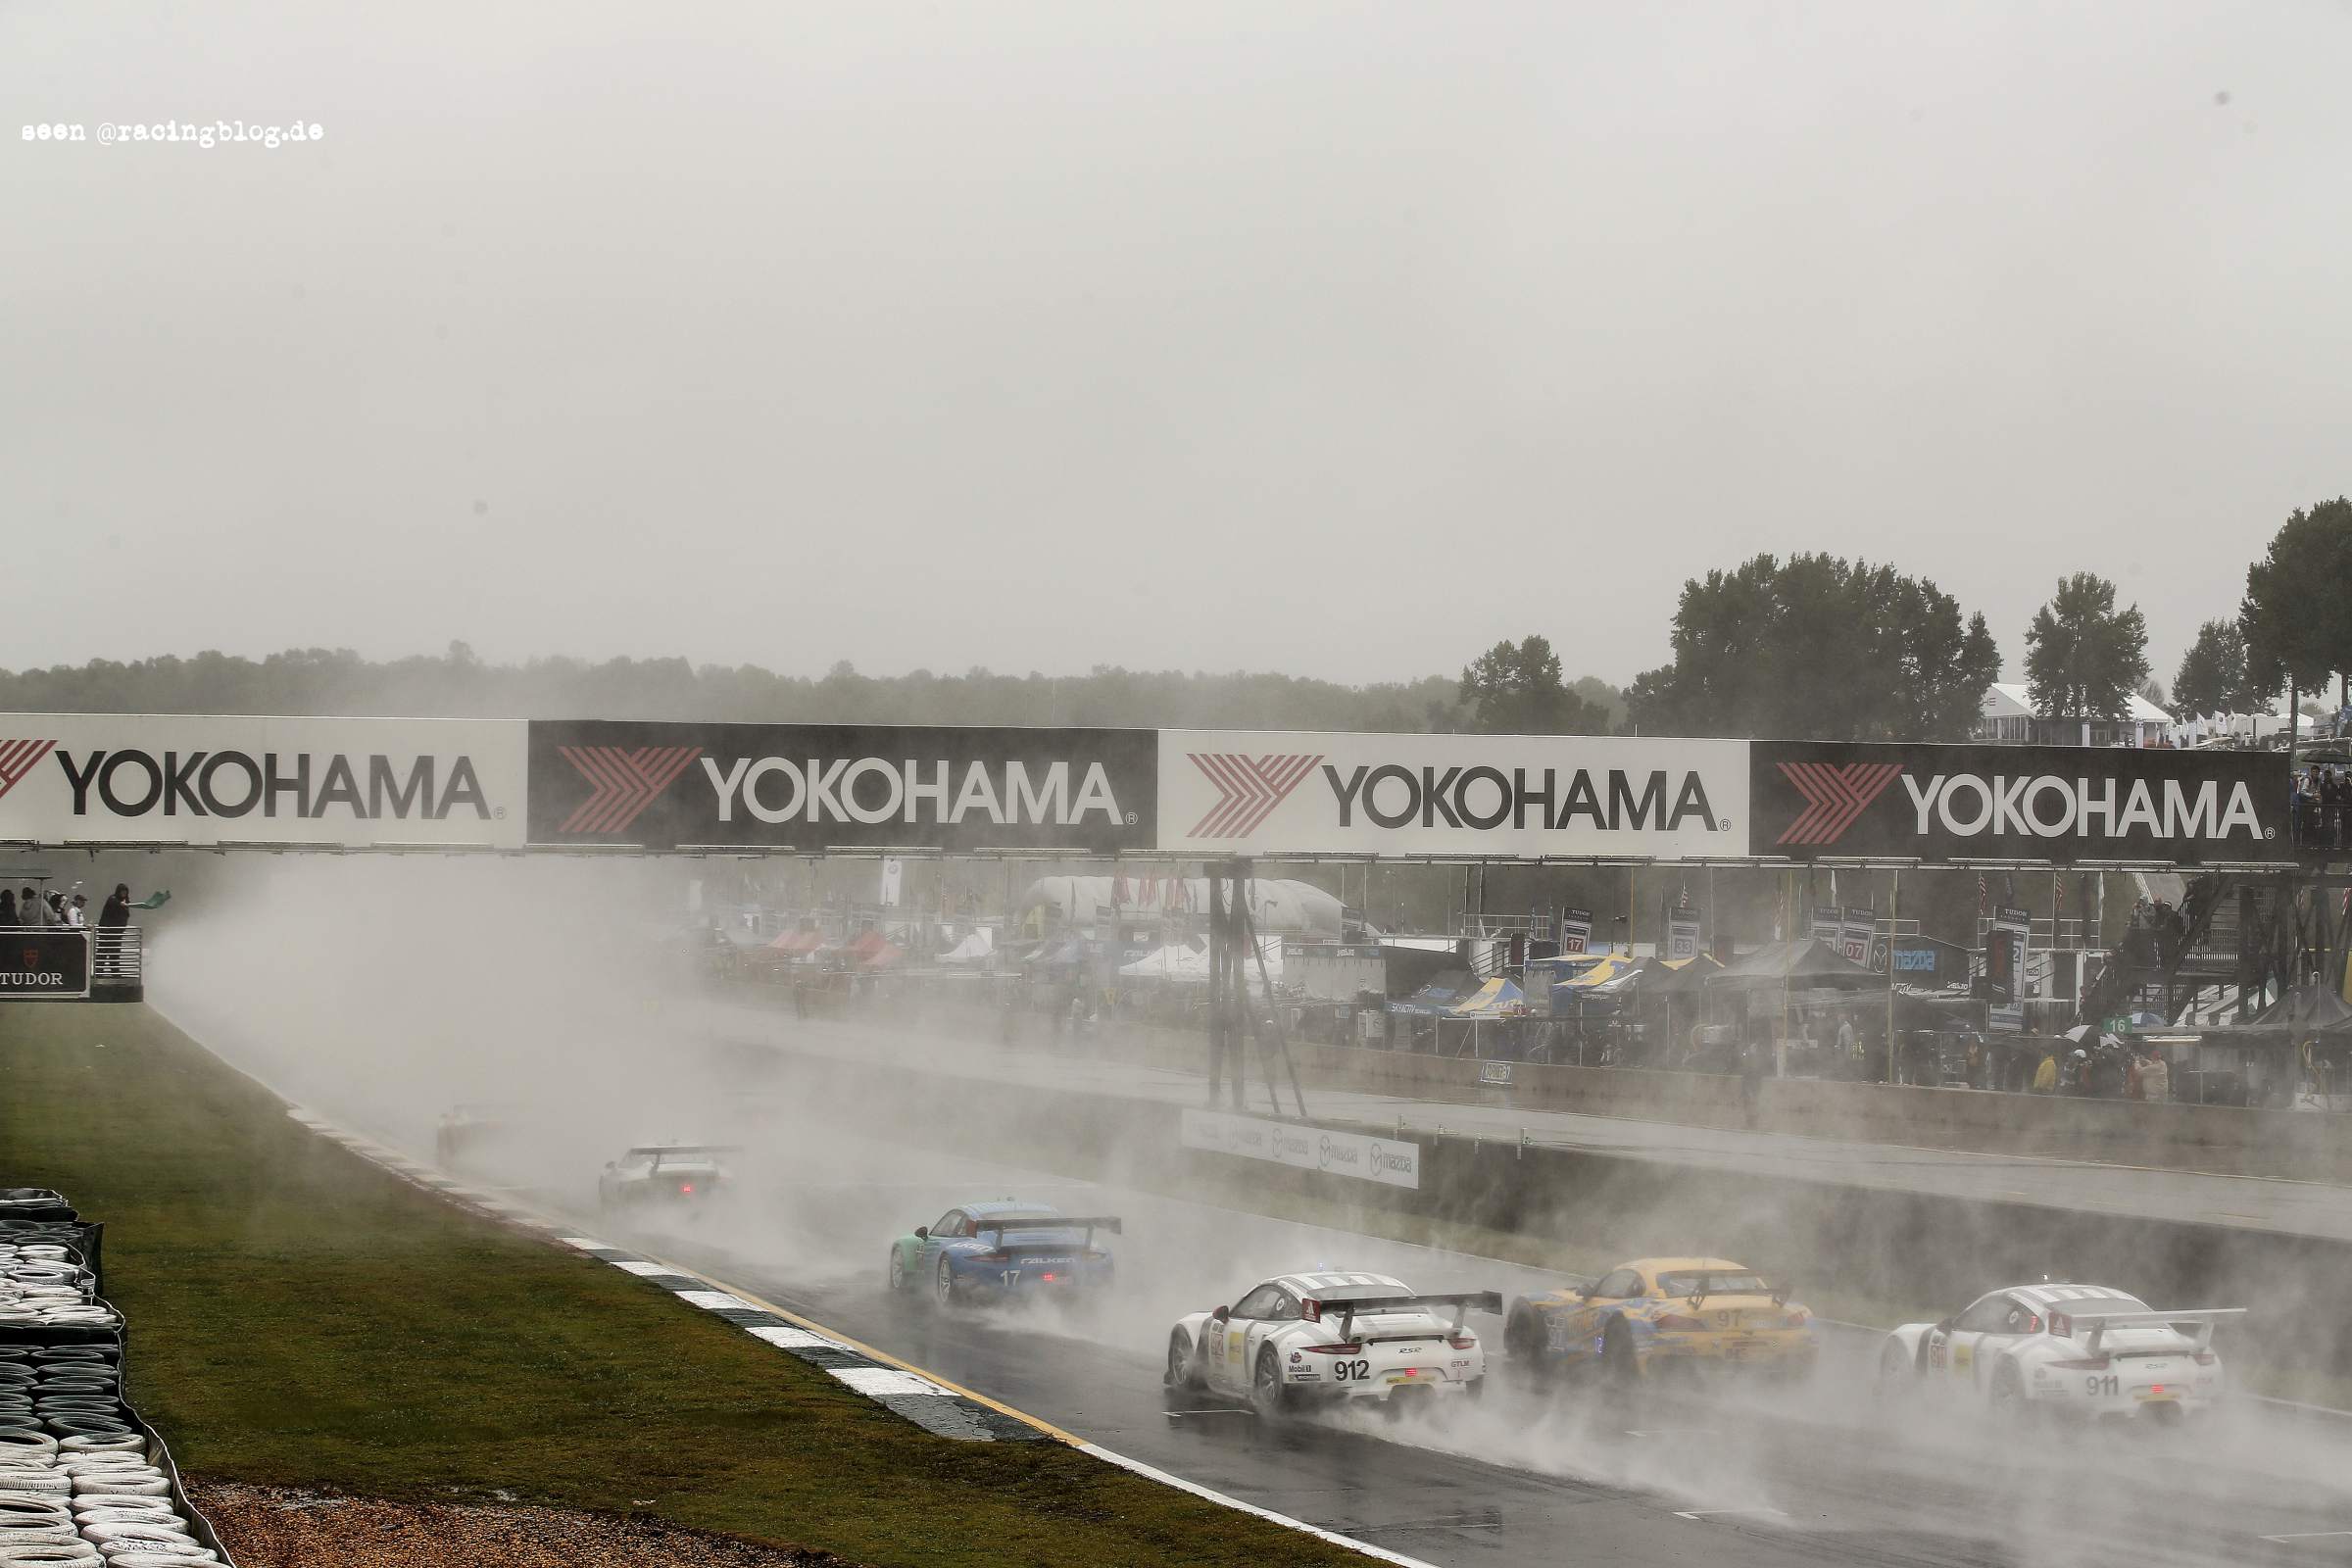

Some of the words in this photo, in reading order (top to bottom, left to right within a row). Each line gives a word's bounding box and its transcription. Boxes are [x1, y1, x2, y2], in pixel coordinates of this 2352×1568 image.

[55, 750, 491, 819] YOKOHAMA
[700, 757, 1124, 828] YOKOHAMA
[1320, 764, 1718, 831] YOKOHAMA
[1901, 774, 2264, 839] YOKOHAMA
[1568, 939, 1582, 951] 17
[1677, 941, 1690, 953] 33
[1846, 944, 1862, 958] 07
[0, 972, 64, 986] TUDOR
[2110, 1019, 2126, 1032] 16
[1383, 1152, 1412, 1173] mazda
[1000, 1269, 1021, 1287] 17
[1717, 1308, 1742, 1327] 97
[1334, 1359, 1371, 1382] 912
[2085, 1375, 2120, 1396] 911
